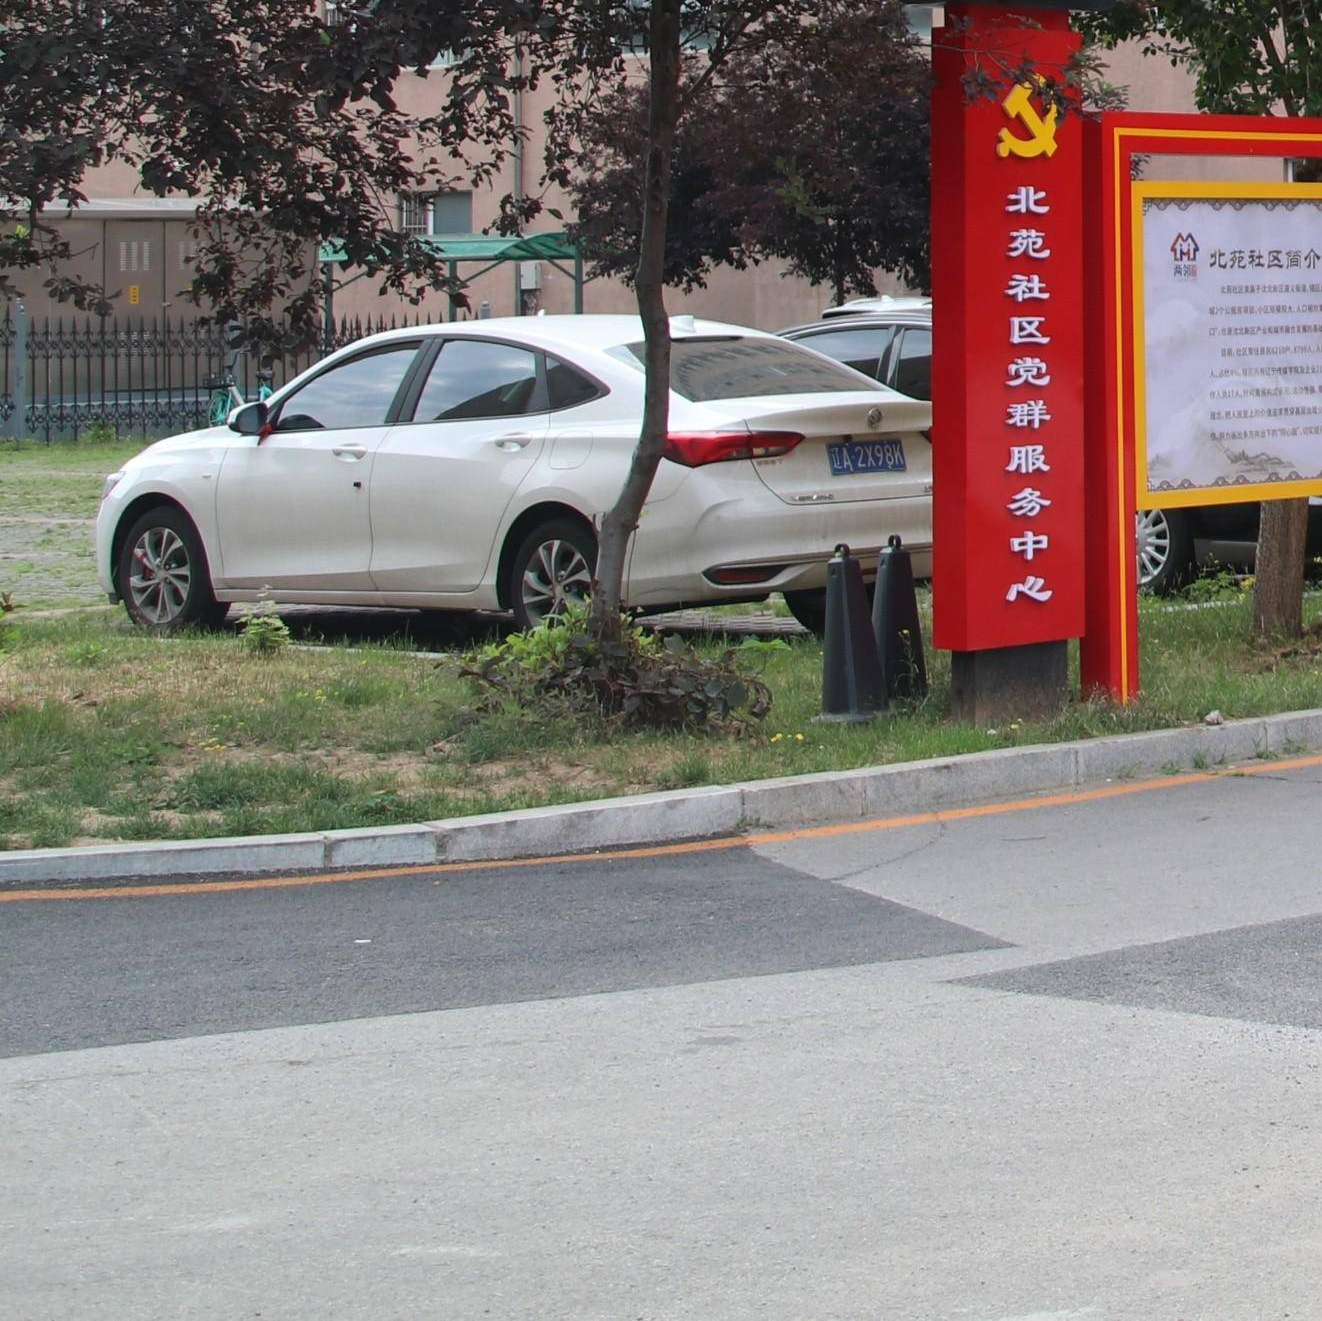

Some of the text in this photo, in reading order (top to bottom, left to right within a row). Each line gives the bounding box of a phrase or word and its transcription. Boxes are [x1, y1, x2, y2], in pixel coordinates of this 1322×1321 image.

[1209, 247, 1321, 271] 北苑社区简介
[1004, 186, 1053, 605] 北苑社区党群服务中心
